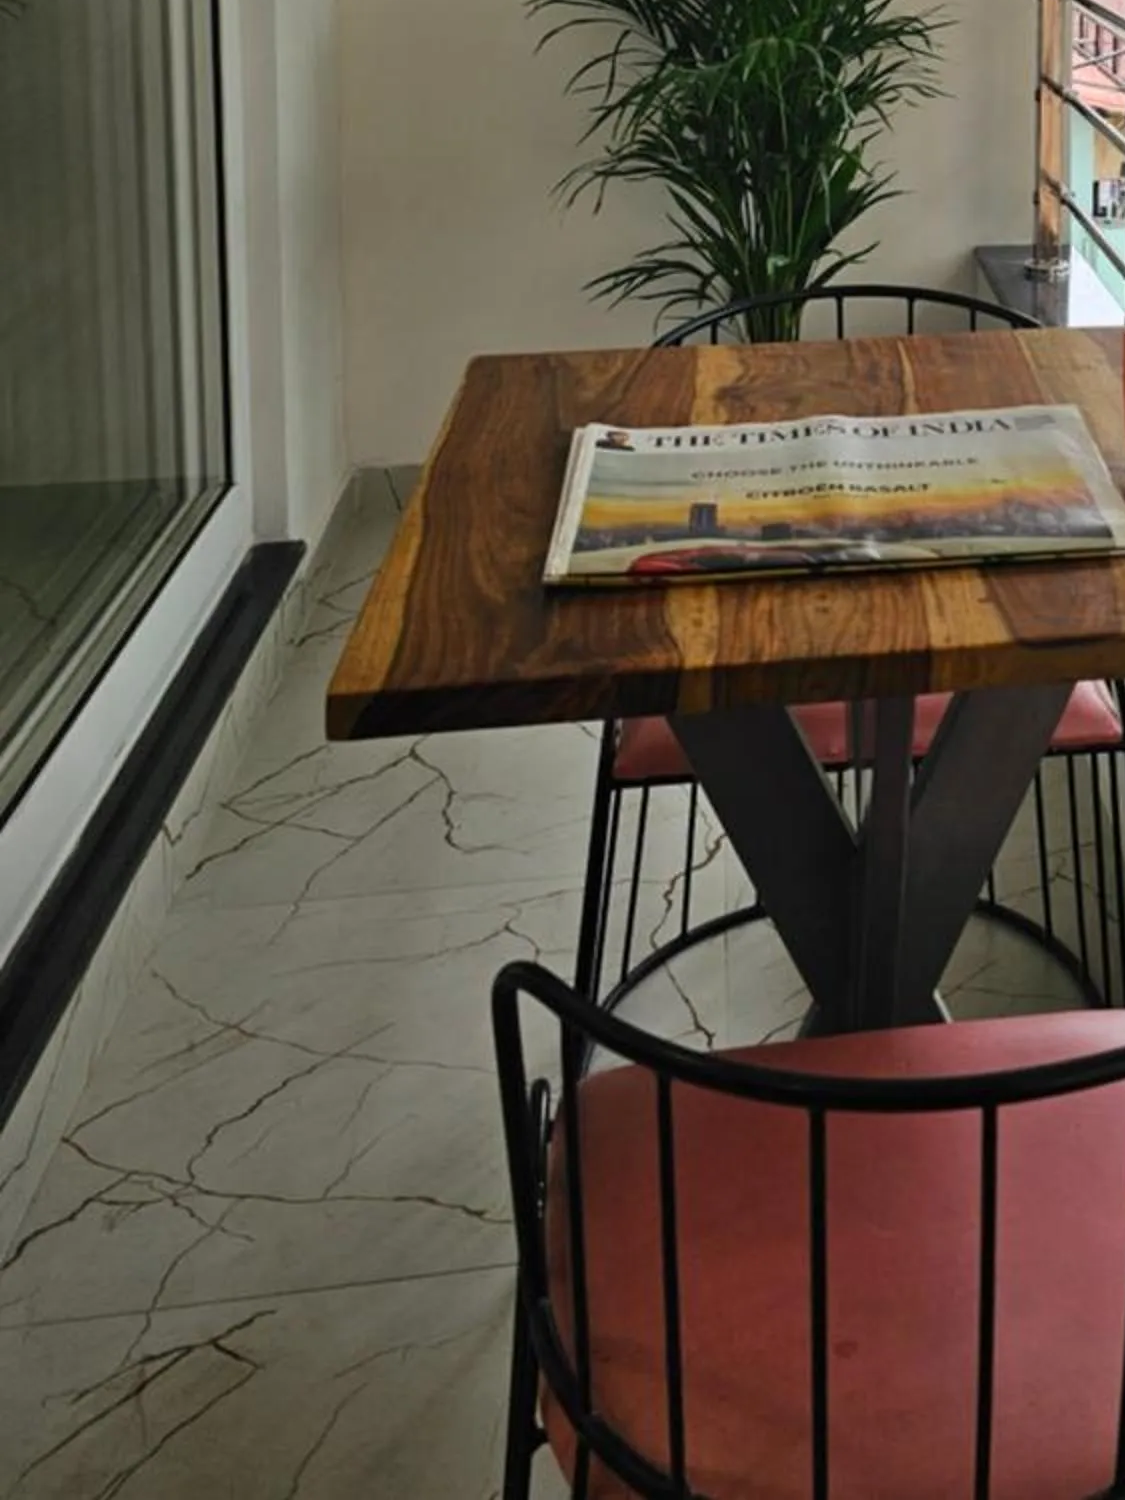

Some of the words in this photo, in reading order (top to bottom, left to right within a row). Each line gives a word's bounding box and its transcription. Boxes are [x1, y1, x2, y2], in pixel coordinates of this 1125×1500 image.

[648, 434, 725, 448] THE
[732, 422, 846, 444] TIMES
[852, 426, 896, 438] OF
[908, 418, 1011, 437] INDIA
